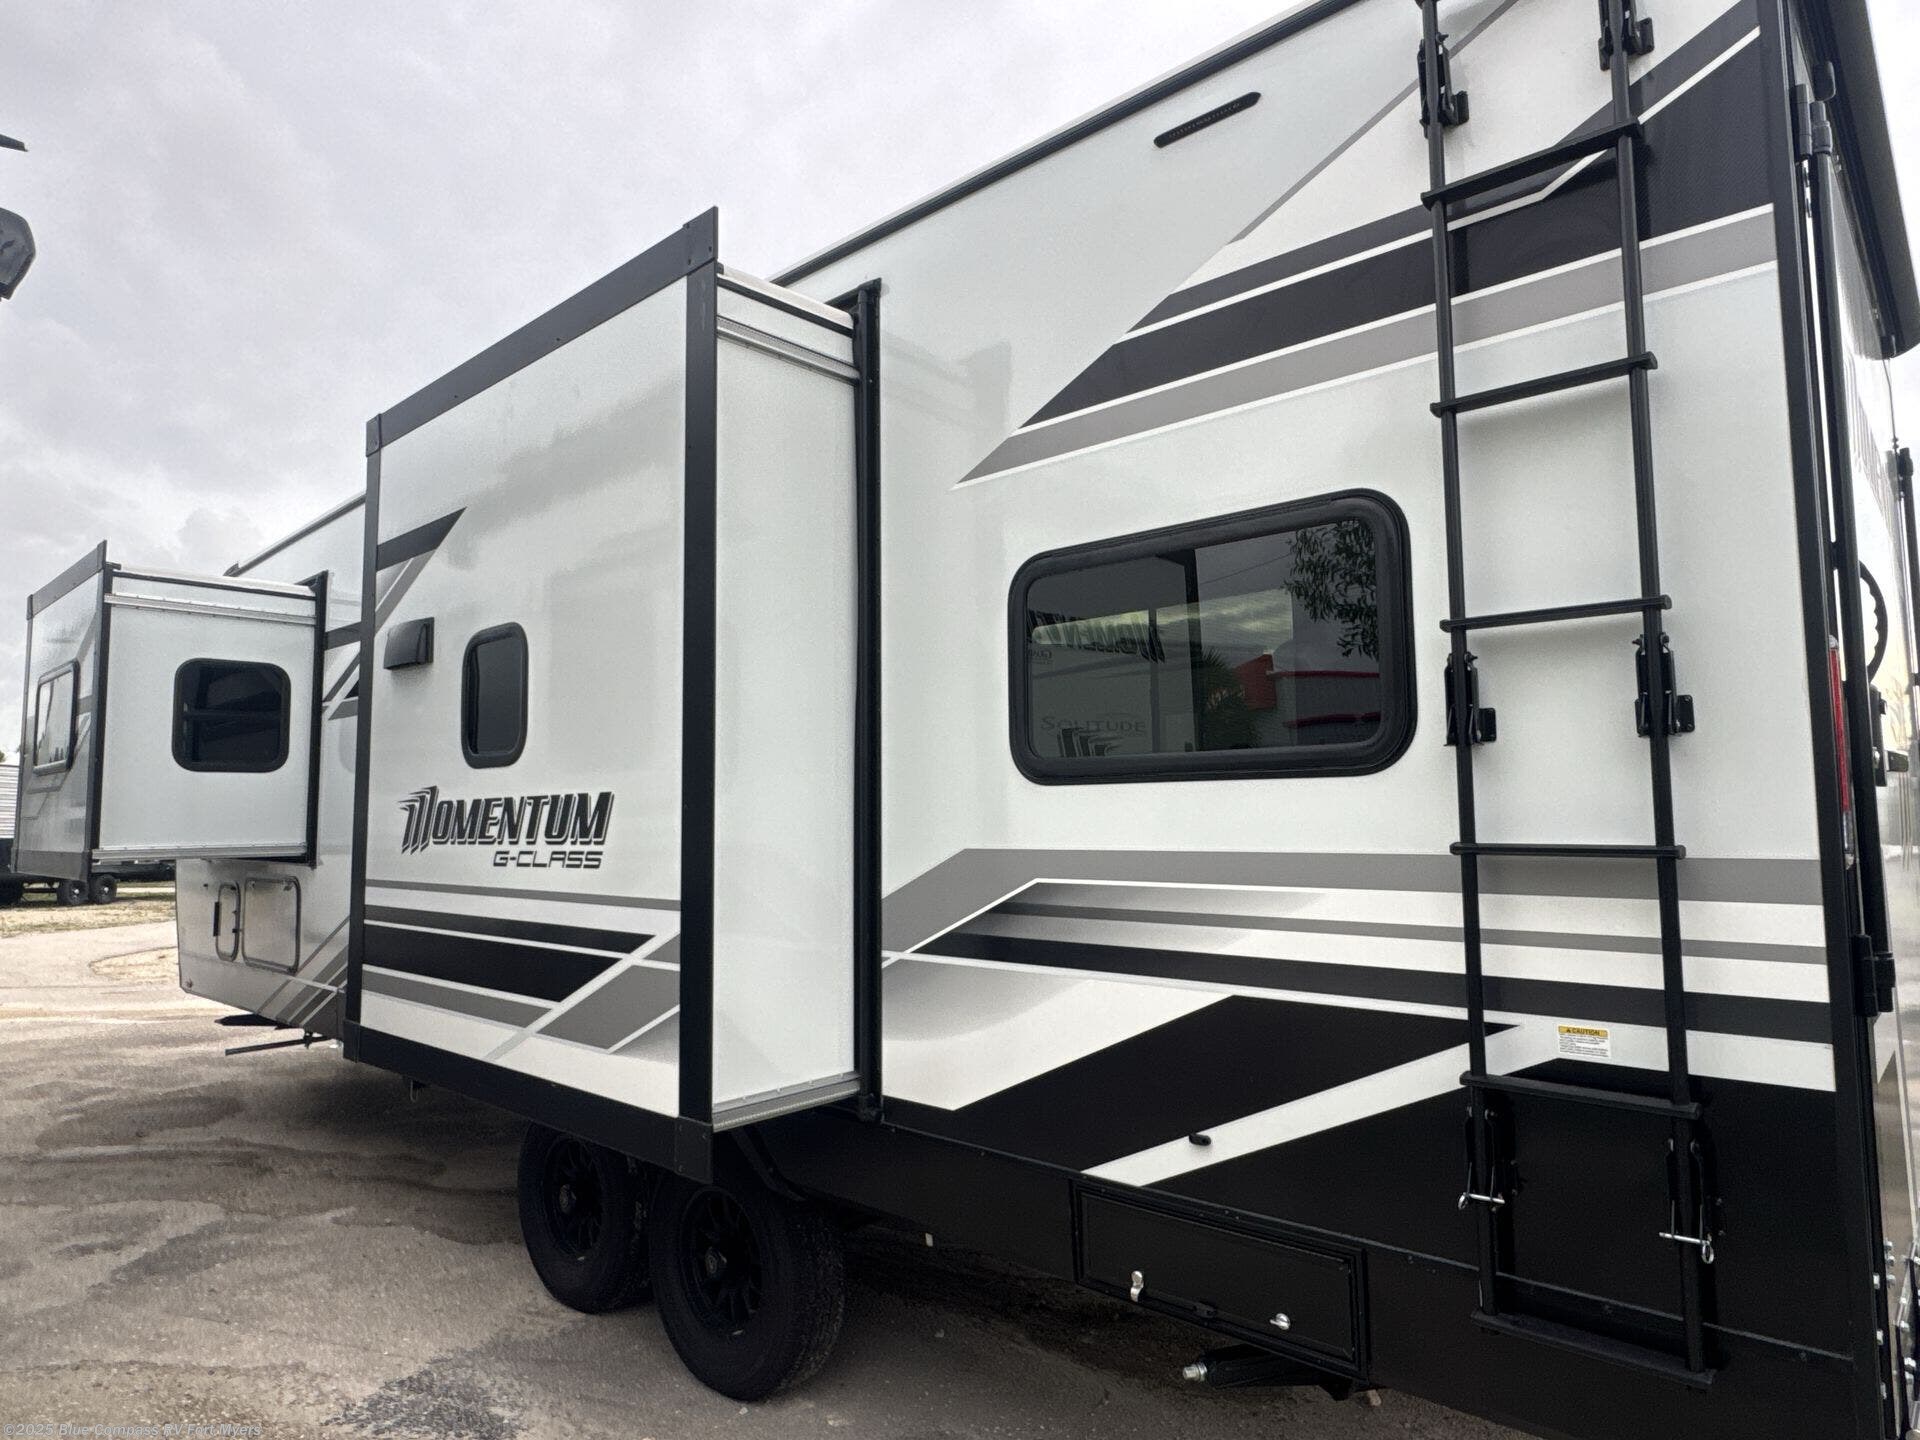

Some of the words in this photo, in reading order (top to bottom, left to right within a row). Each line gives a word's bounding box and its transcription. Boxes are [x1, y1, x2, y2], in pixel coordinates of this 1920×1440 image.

[398, 785, 615, 855] MOMENTUM
[493, 851, 603, 869] G-CLASS
[1572, 1028, 1600, 1036] CAUTION
